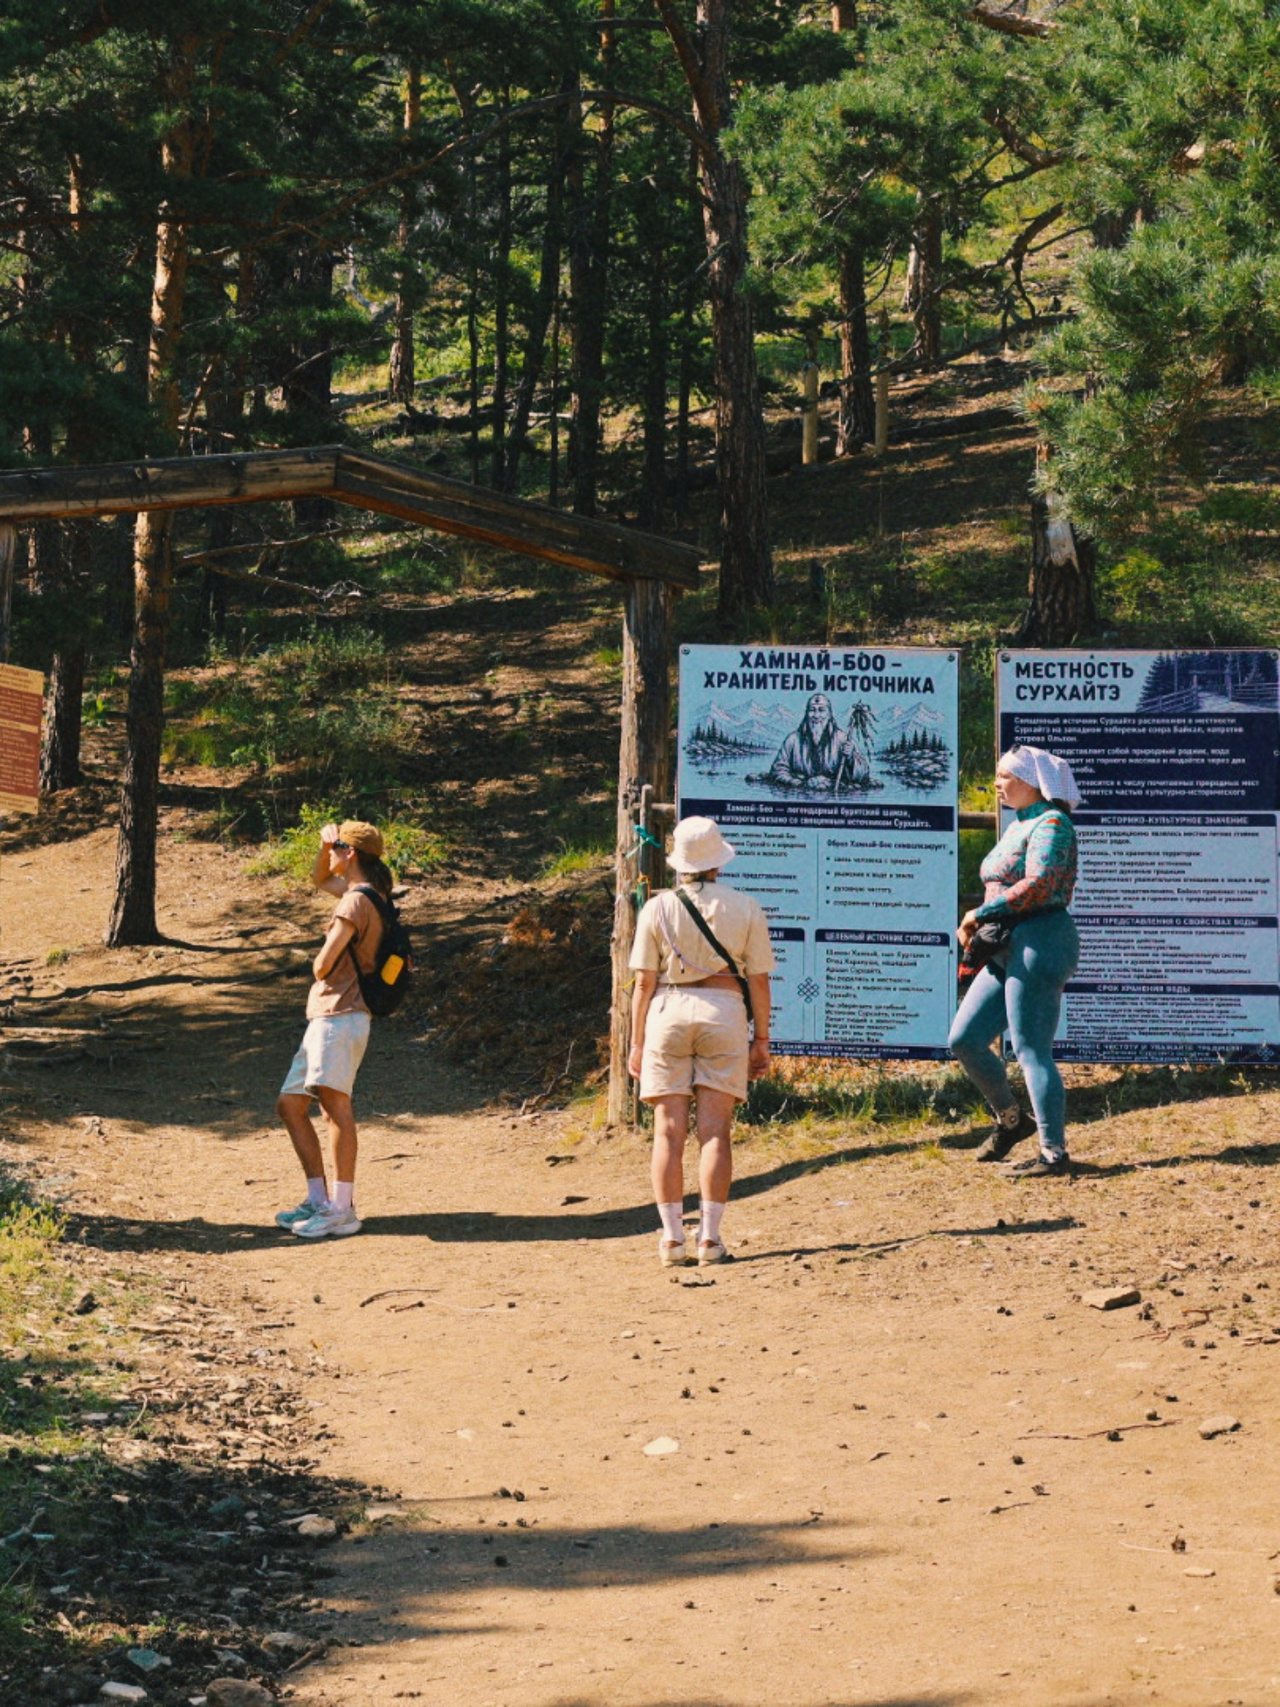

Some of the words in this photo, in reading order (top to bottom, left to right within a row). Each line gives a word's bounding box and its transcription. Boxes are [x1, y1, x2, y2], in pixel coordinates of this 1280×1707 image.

[739, 647, 885, 672] ХАМНАЙ-БОО
[1015, 661, 1134, 678] МЕСТНОСТЬ
[703, 671, 817, 691] ХРАНИТЕЛЬ
[823, 674, 934, 694] ИСТОЧНИКА
[1015, 681, 1120, 701] СУРХАЙТЭ
